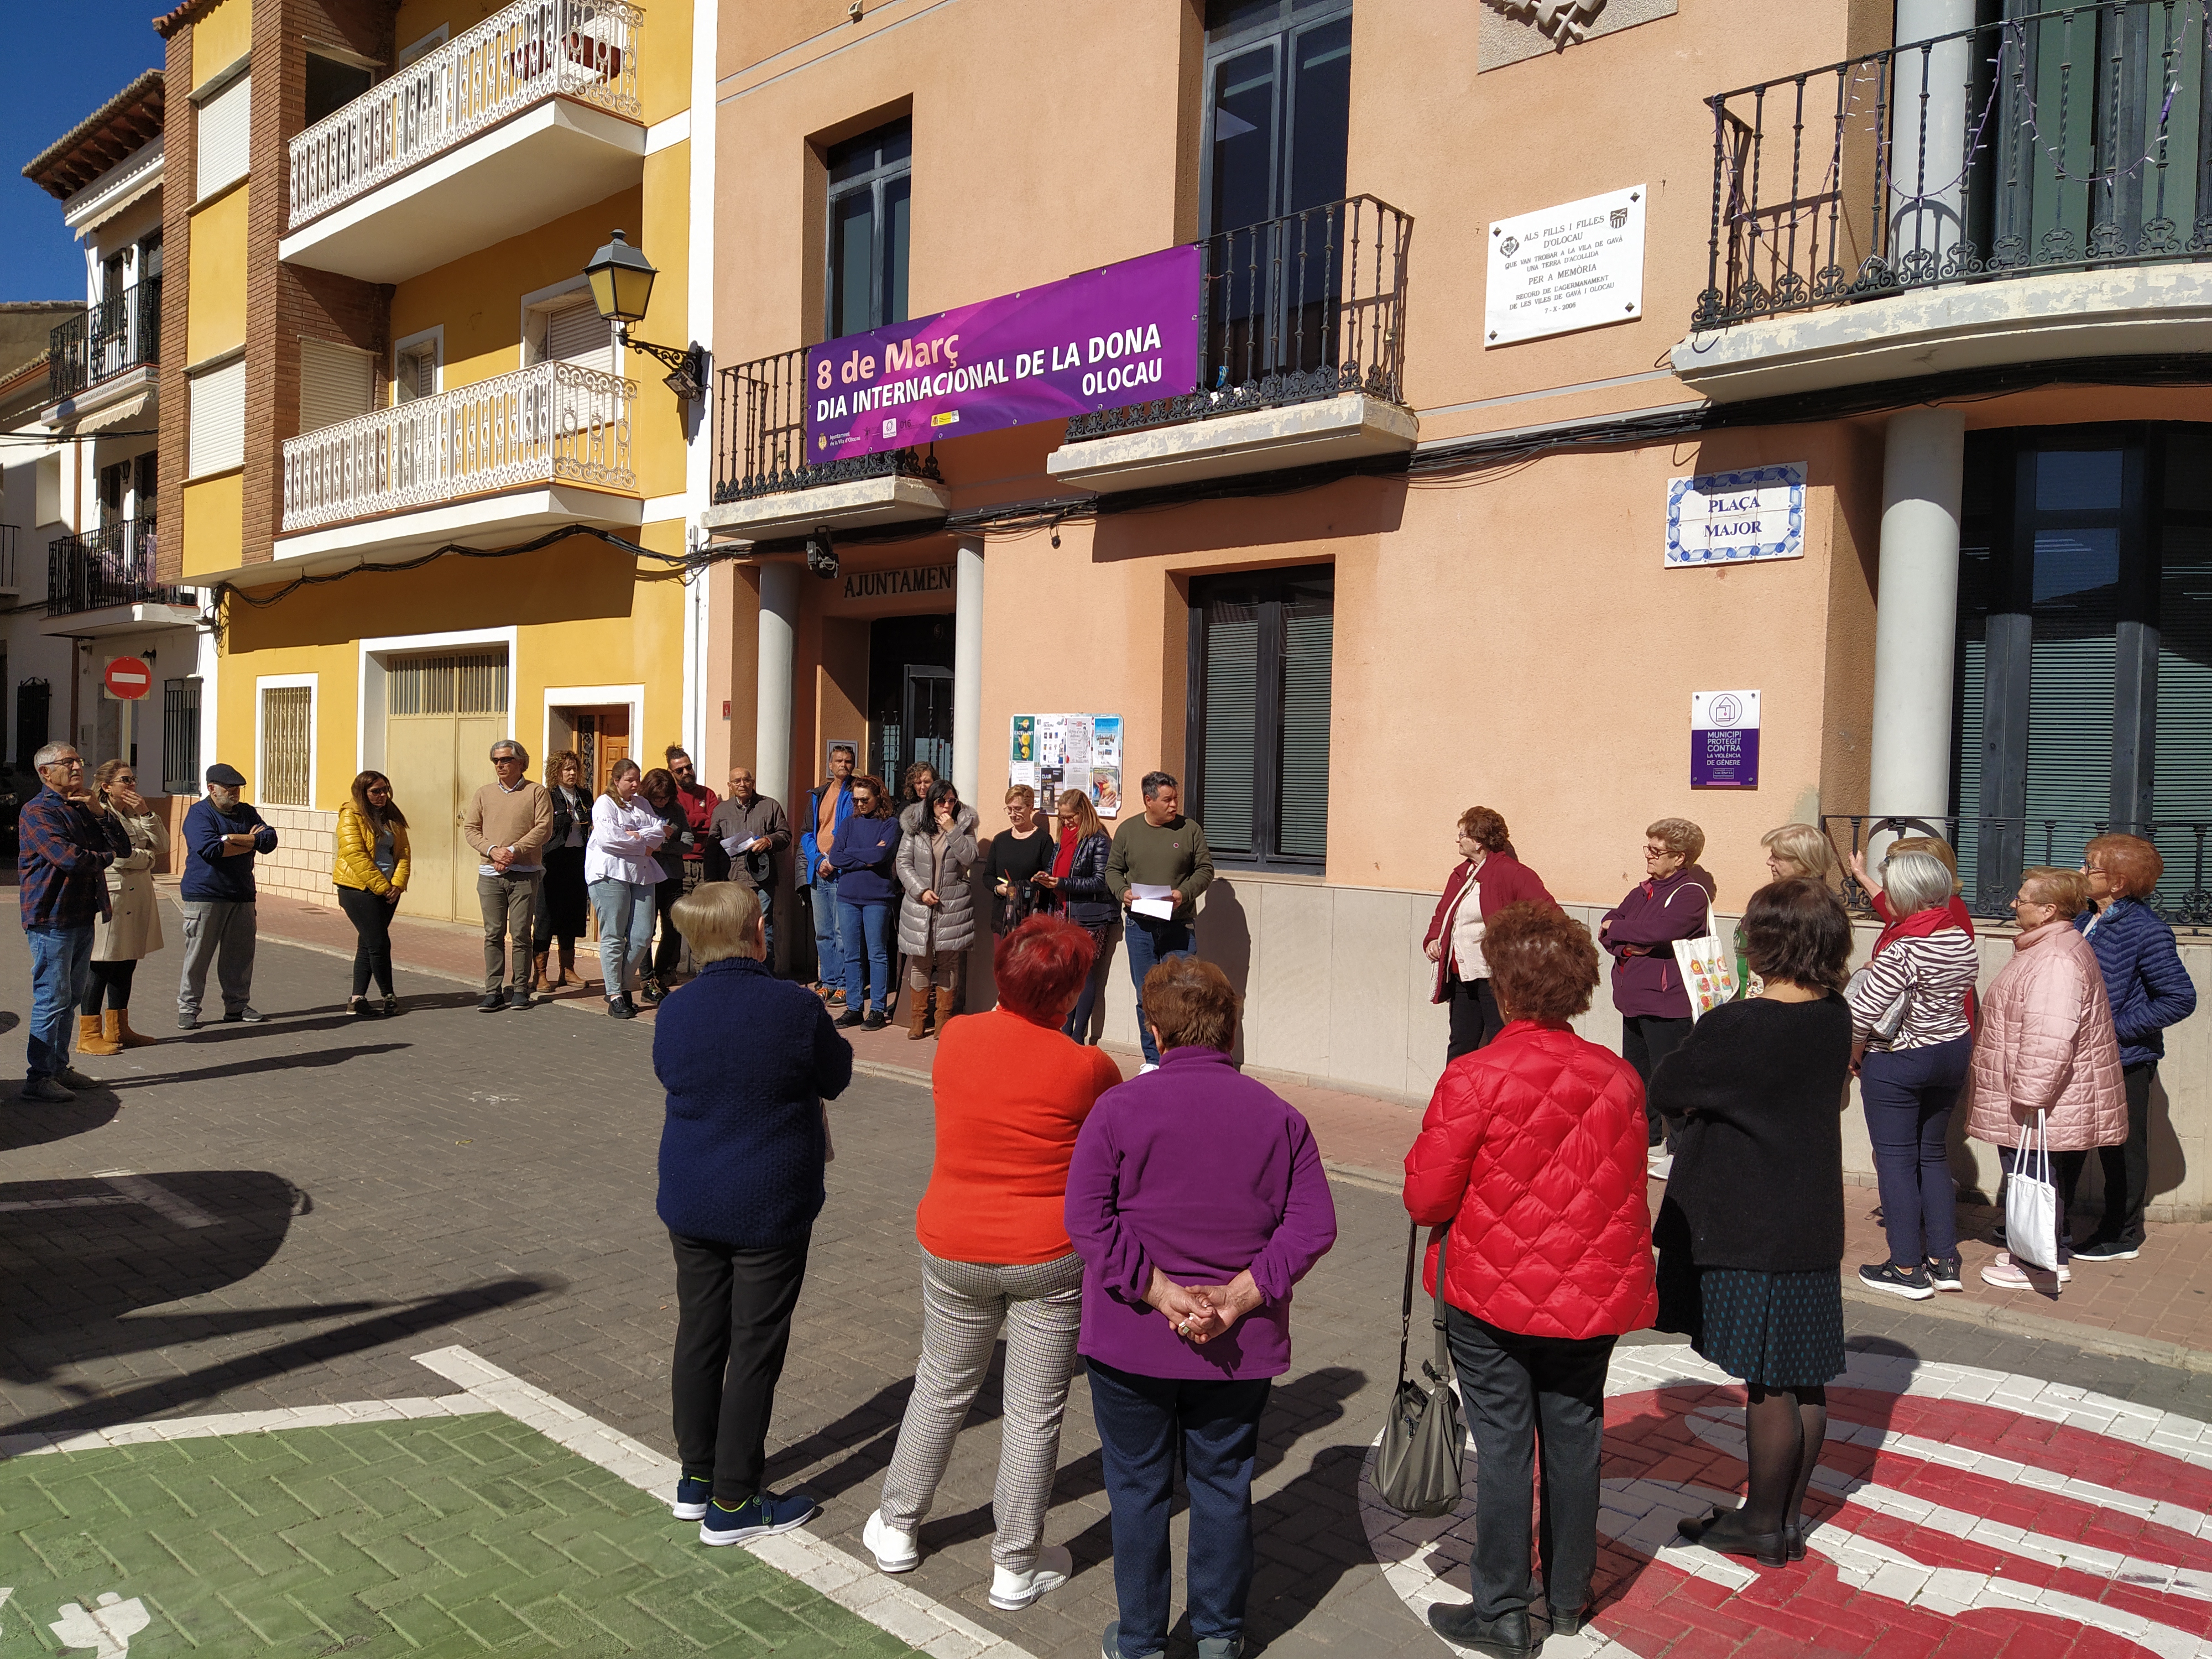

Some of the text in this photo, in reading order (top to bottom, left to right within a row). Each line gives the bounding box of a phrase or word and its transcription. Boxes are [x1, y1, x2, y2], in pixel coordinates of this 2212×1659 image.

[1524, 231, 1539, 242] ALS
[1543, 225, 1564, 237] FILLS
[1577, 216, 1604, 229] FILLES
[1544, 232, 1583, 248] D'OLOCAU
[1505, 260, 1517, 270] QUE
[1520, 257, 1531, 265] VAN
[1535, 251, 1558, 262] TROBAR
[1578, 244, 1592, 252] VILA
[1607, 234, 1623, 246] GAVÀ
[1527, 251, 1598, 272] UNA TERRA D'ACOLLIDA
[1528, 275, 1544, 285] PER
[1557, 264, 1597, 278] MEMÒRIA
[1516, 290, 1540, 300] RECORD
[1554, 275, 1609, 292] L'AGERMANAMENT
[1535, 296, 1551, 305] VILES
[1566, 288, 1581, 298] GAVÀ
[1590, 282, 1614, 293] OLOCAU
[817, 333, 959, 390] 8 de Març
[817, 324, 1162, 422] DIA INTERNACIONAL DE LA DONA
[1082, 358, 1162, 396] OLOCAU
[900, 420, 911, 429] 016
[1708, 496, 1761, 512] PLAÇA
[1704, 521, 1762, 537] MAJOR
